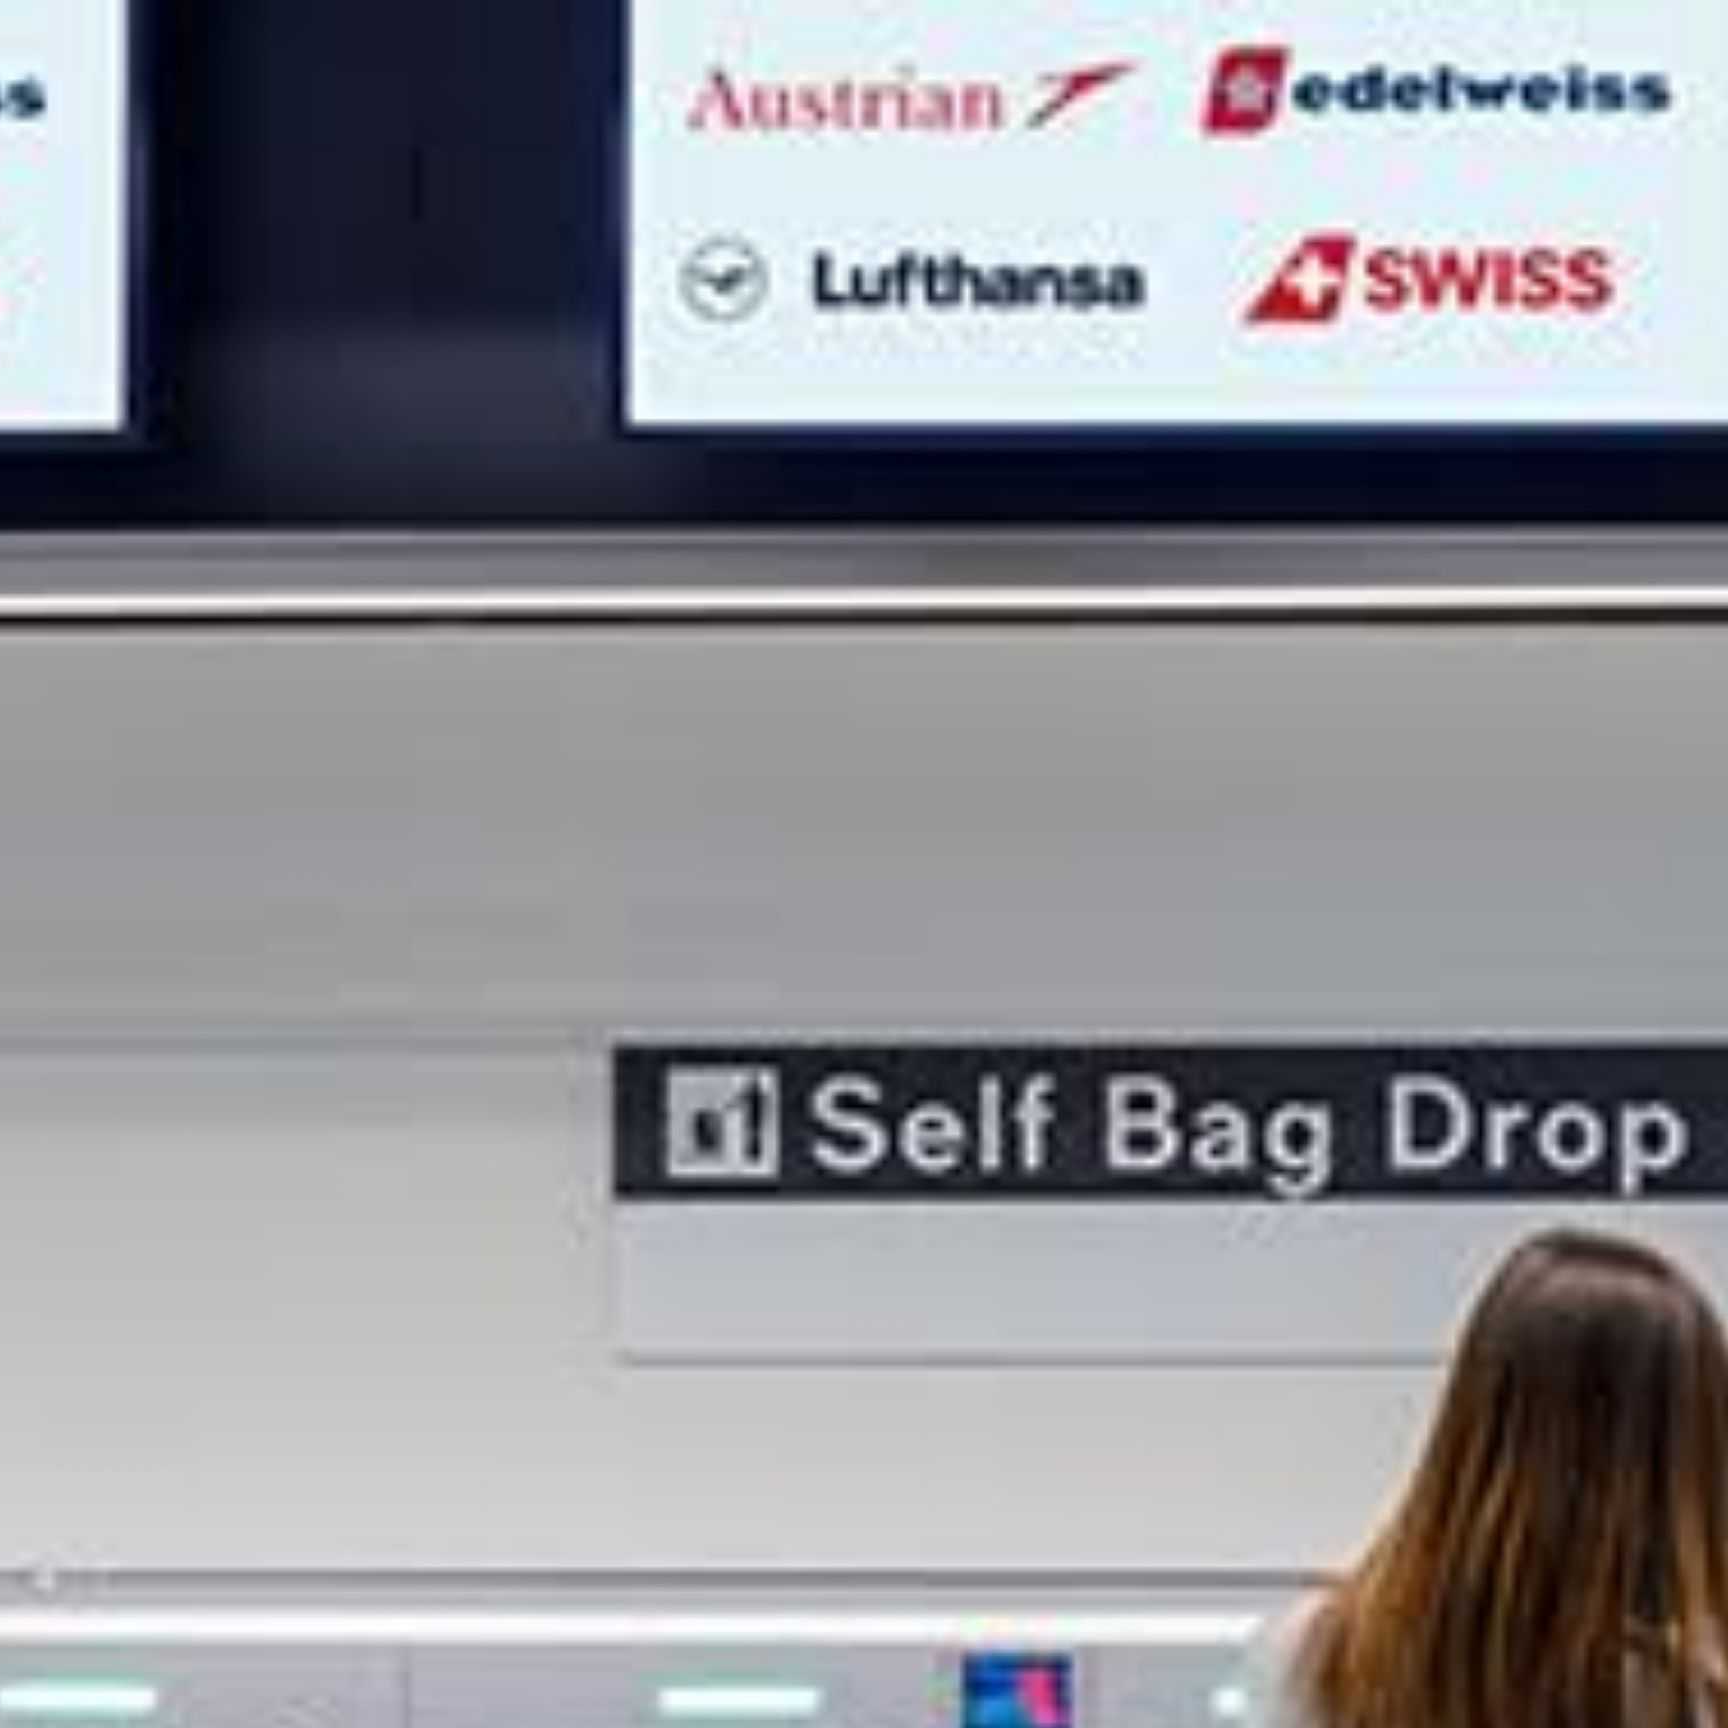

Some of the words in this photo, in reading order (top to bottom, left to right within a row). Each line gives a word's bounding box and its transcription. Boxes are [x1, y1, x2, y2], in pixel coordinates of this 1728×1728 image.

[685, 65, 1004, 132] Austrian
[1290, 60, 1673, 116] edelweiss
[810, 249, 1147, 312] Lufthansa
[1363, 246, 1614, 313] SWISS
[811, 1072, 1055, 1174] Self
[1104, 1074, 1333, 1198] Bag
[1388, 1074, 1688, 1195] Drop
